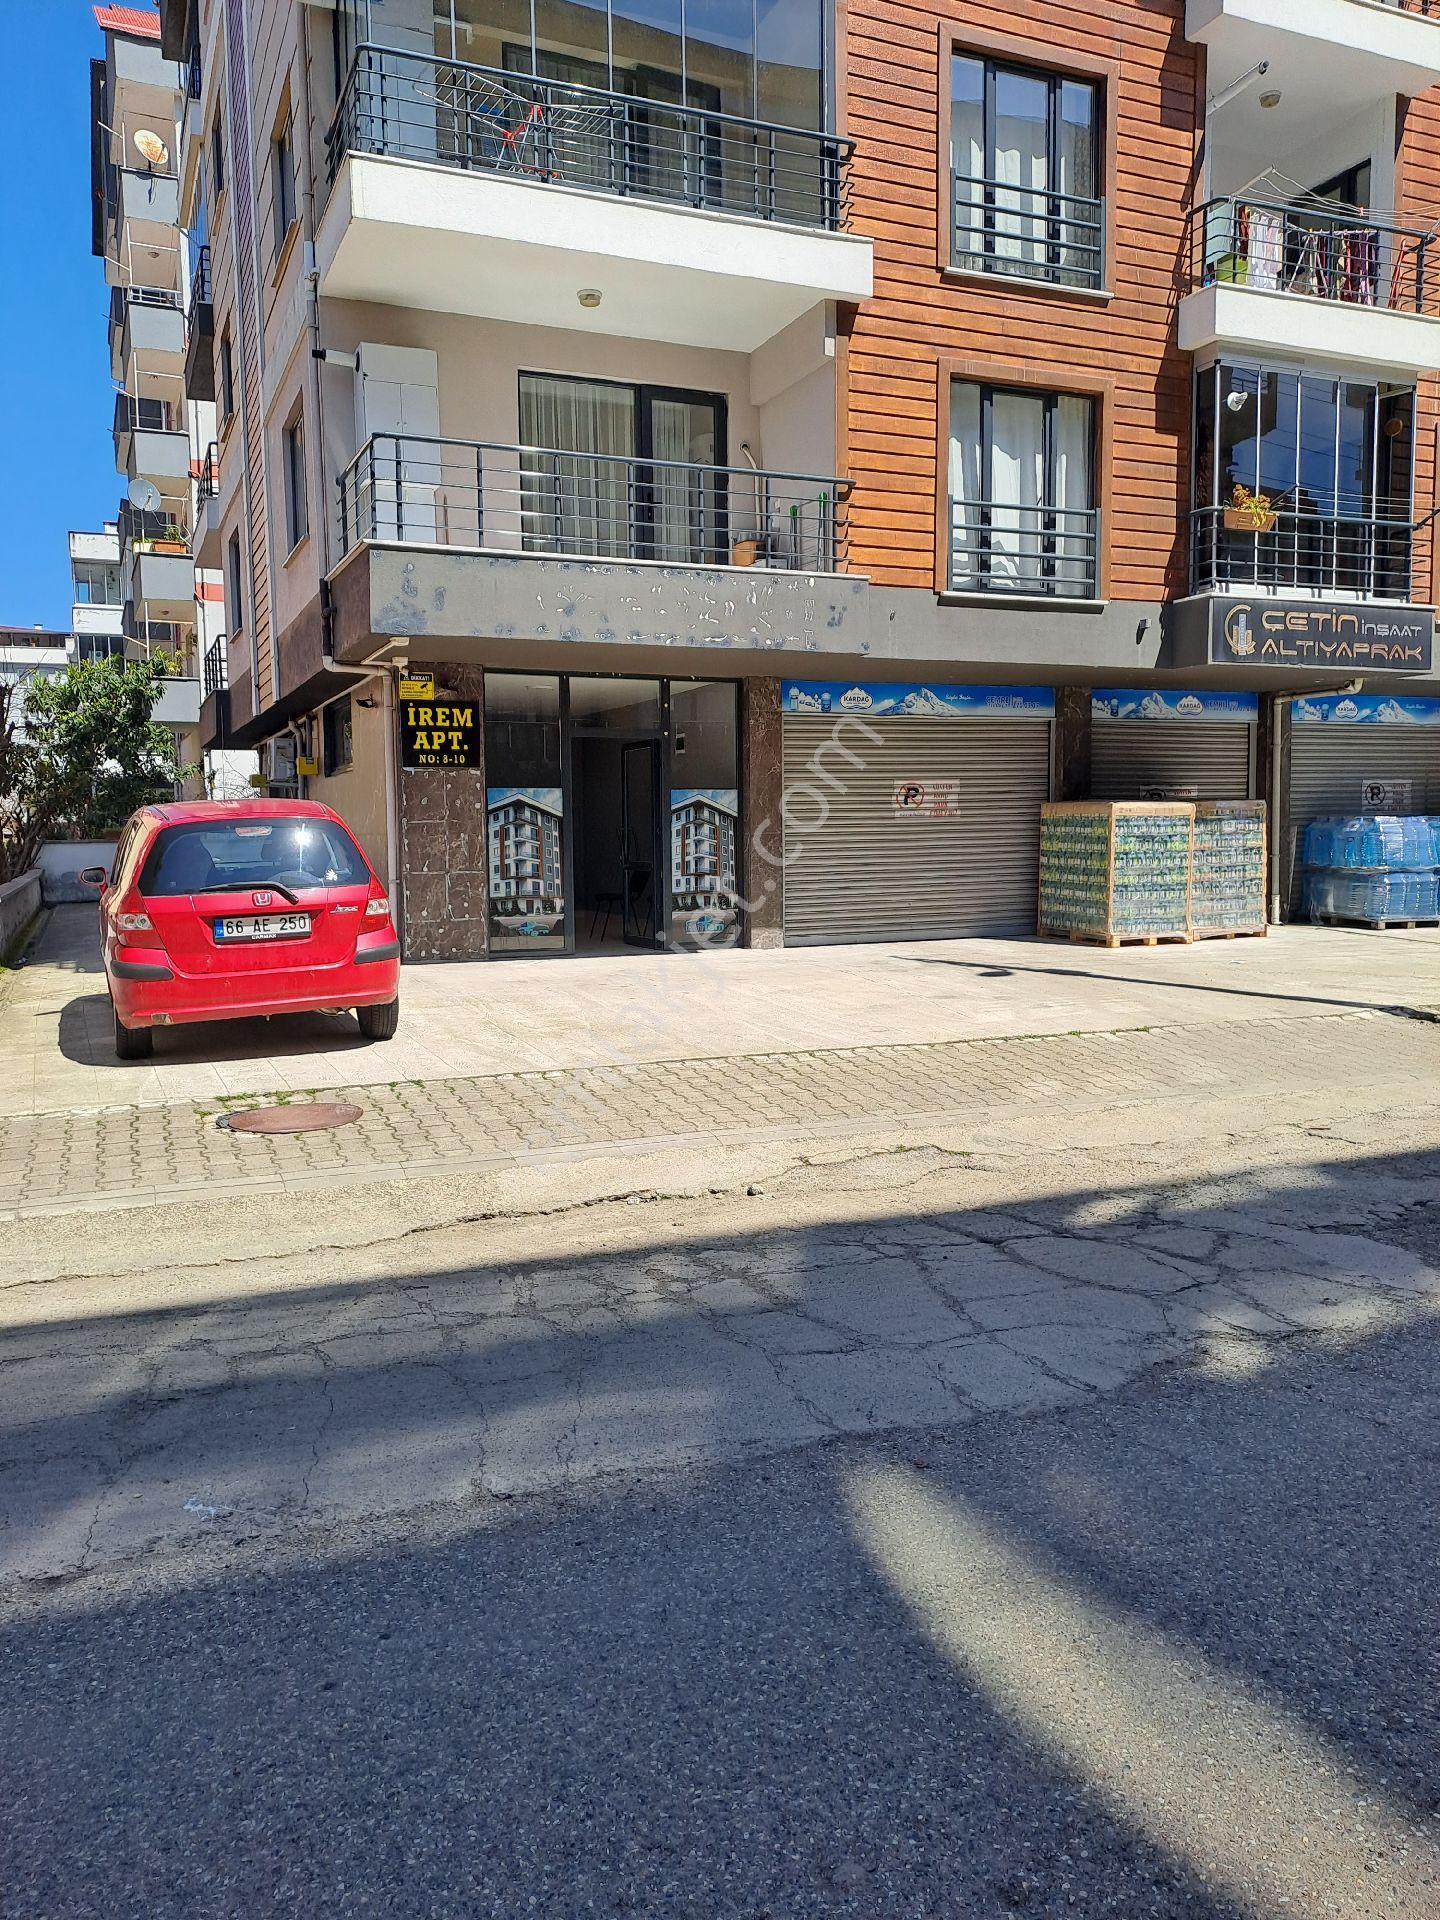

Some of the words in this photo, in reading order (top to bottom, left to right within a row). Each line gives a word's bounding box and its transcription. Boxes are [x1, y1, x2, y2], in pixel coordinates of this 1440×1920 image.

[1261, 638, 1423, 661] ALTIYAPRAK
[407, 702, 473, 727] İREM
[413, 731, 469, 750] APT.
[419, 754, 440, 764] NO:
[226, 920, 244, 935] 66
[253, 918, 271, 933] AE
[279, 916, 306, 931] 250
